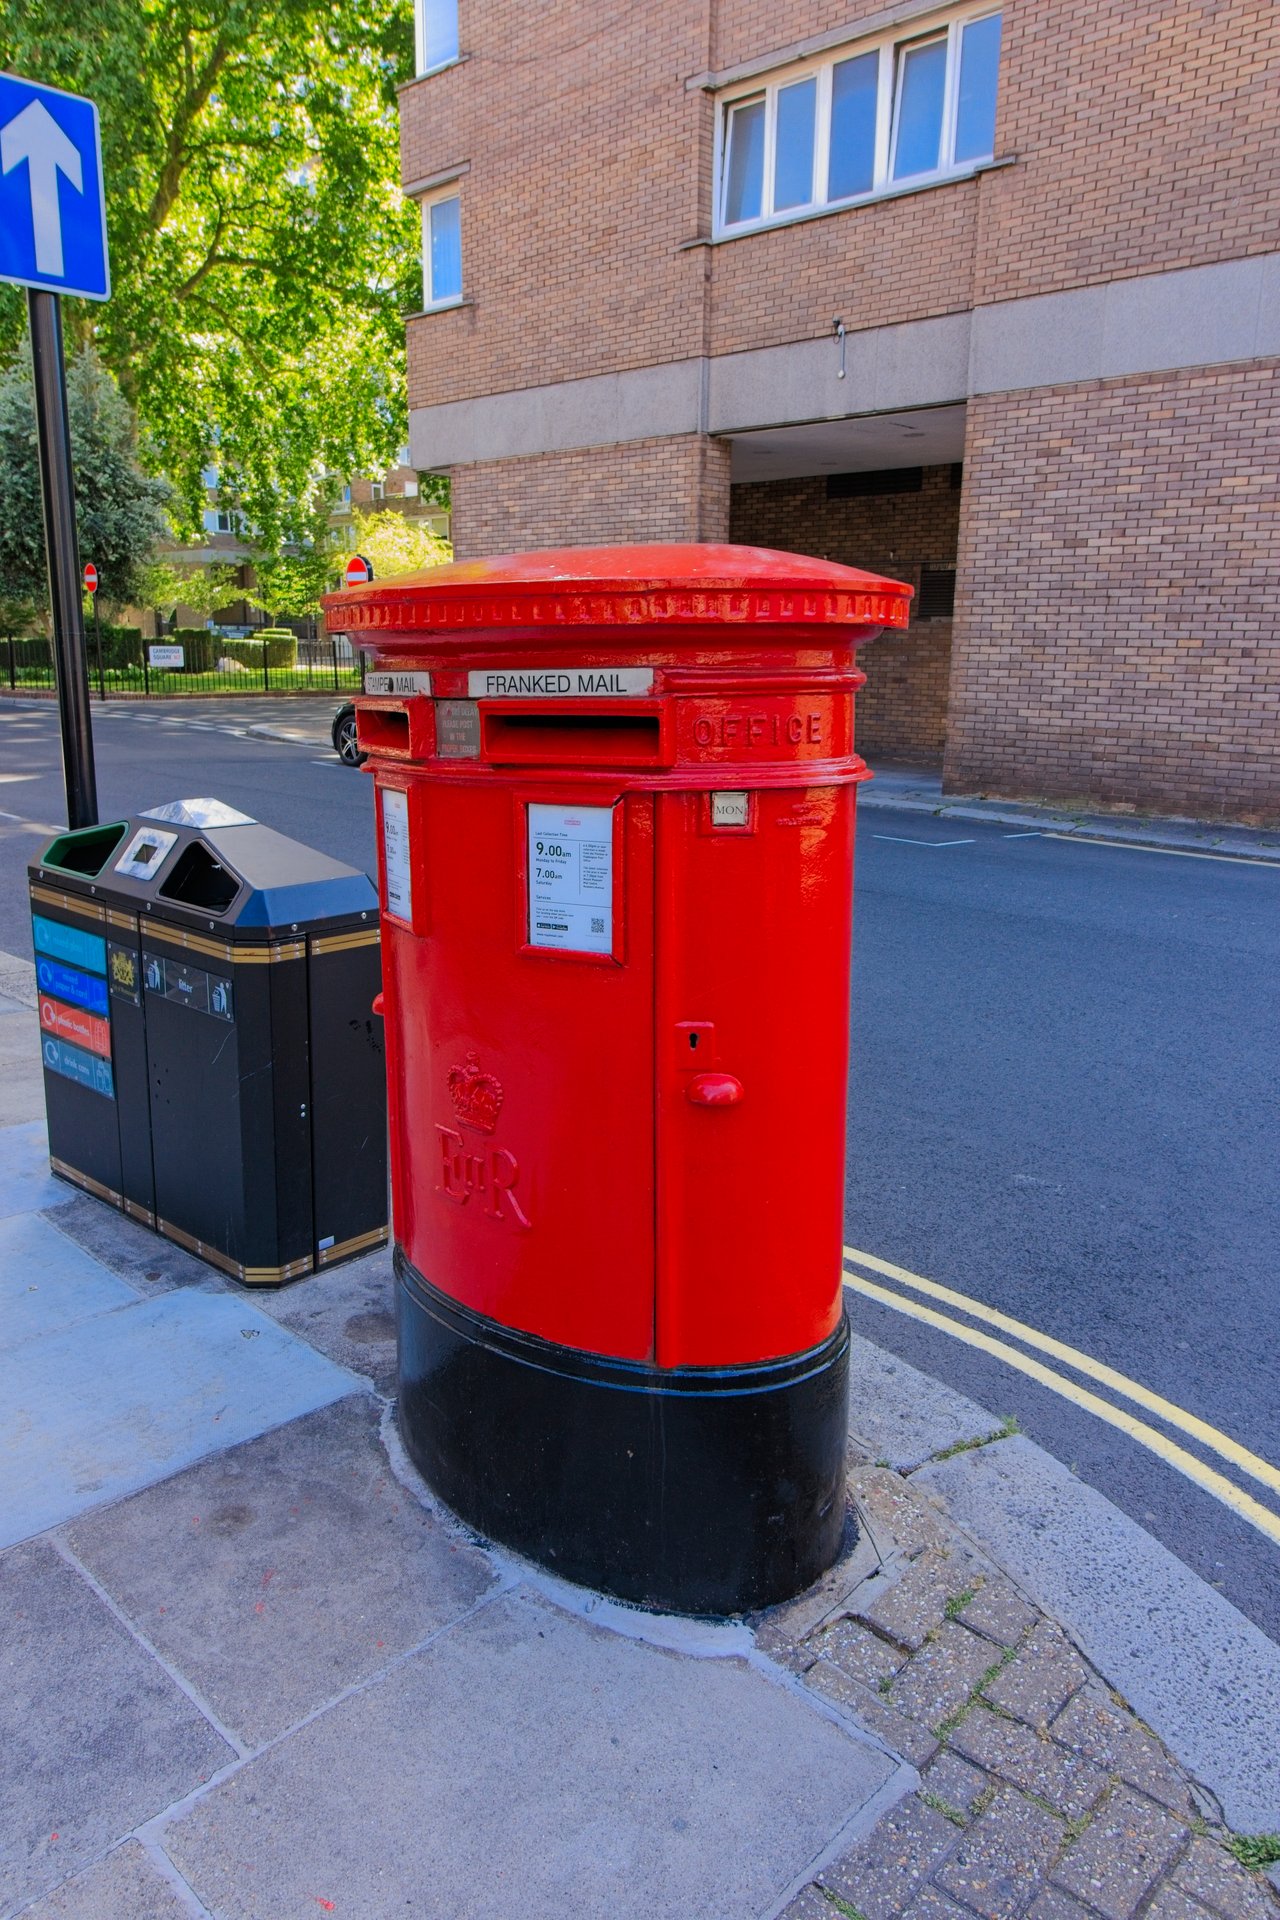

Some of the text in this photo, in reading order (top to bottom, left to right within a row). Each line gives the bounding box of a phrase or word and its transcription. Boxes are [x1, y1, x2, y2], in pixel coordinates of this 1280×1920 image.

[367, 676, 418, 692] STAMPE MAIL
[486, 674, 627, 693] FRANKED MAIL
[693, 711, 822, 745] OFFICE
[716, 806, 743, 815] MON
[536, 841, 572, 858] 9.00am
[535, 867, 563, 879] 7.00am
[178, 978, 193, 993] litter
[72, 1021, 90, 1036] bottles
